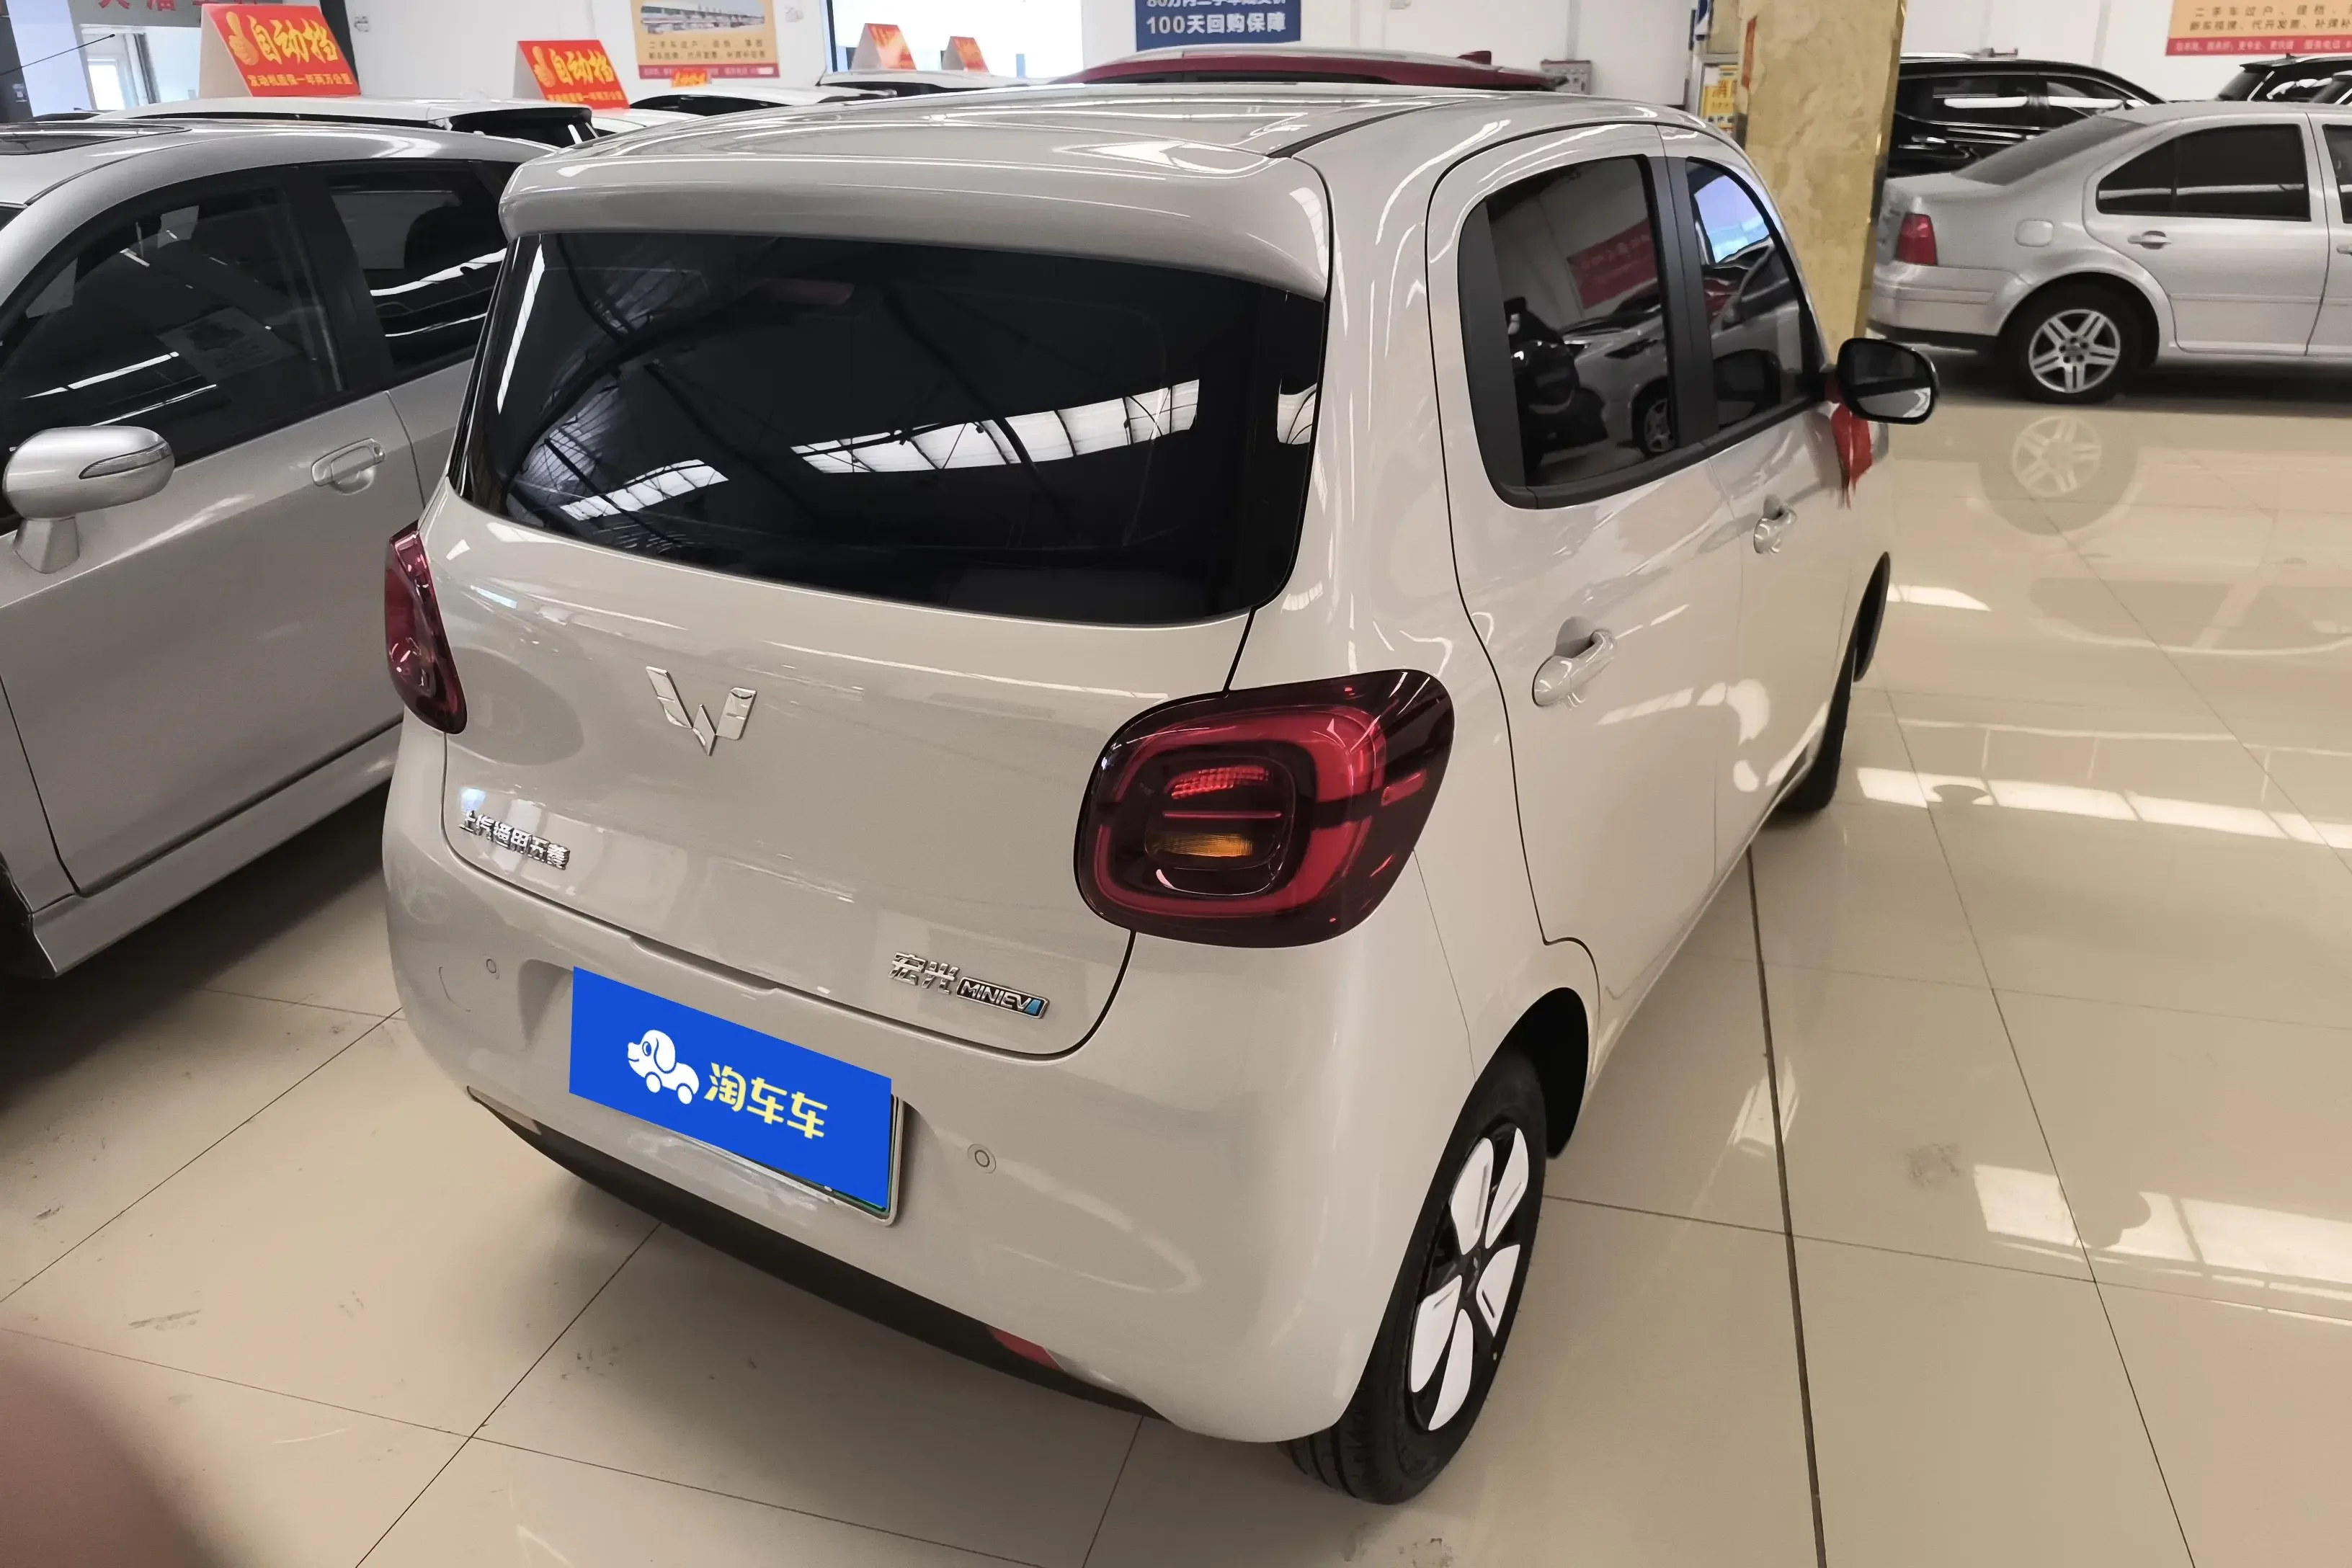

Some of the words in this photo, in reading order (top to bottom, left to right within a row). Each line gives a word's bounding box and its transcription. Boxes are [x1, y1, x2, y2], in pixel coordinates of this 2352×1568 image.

[1146, 12, 1286, 34] 100天回购保障
[458, 809, 571, 870] 上汽通用五菱
[888, 952, 960, 995] 宏光
